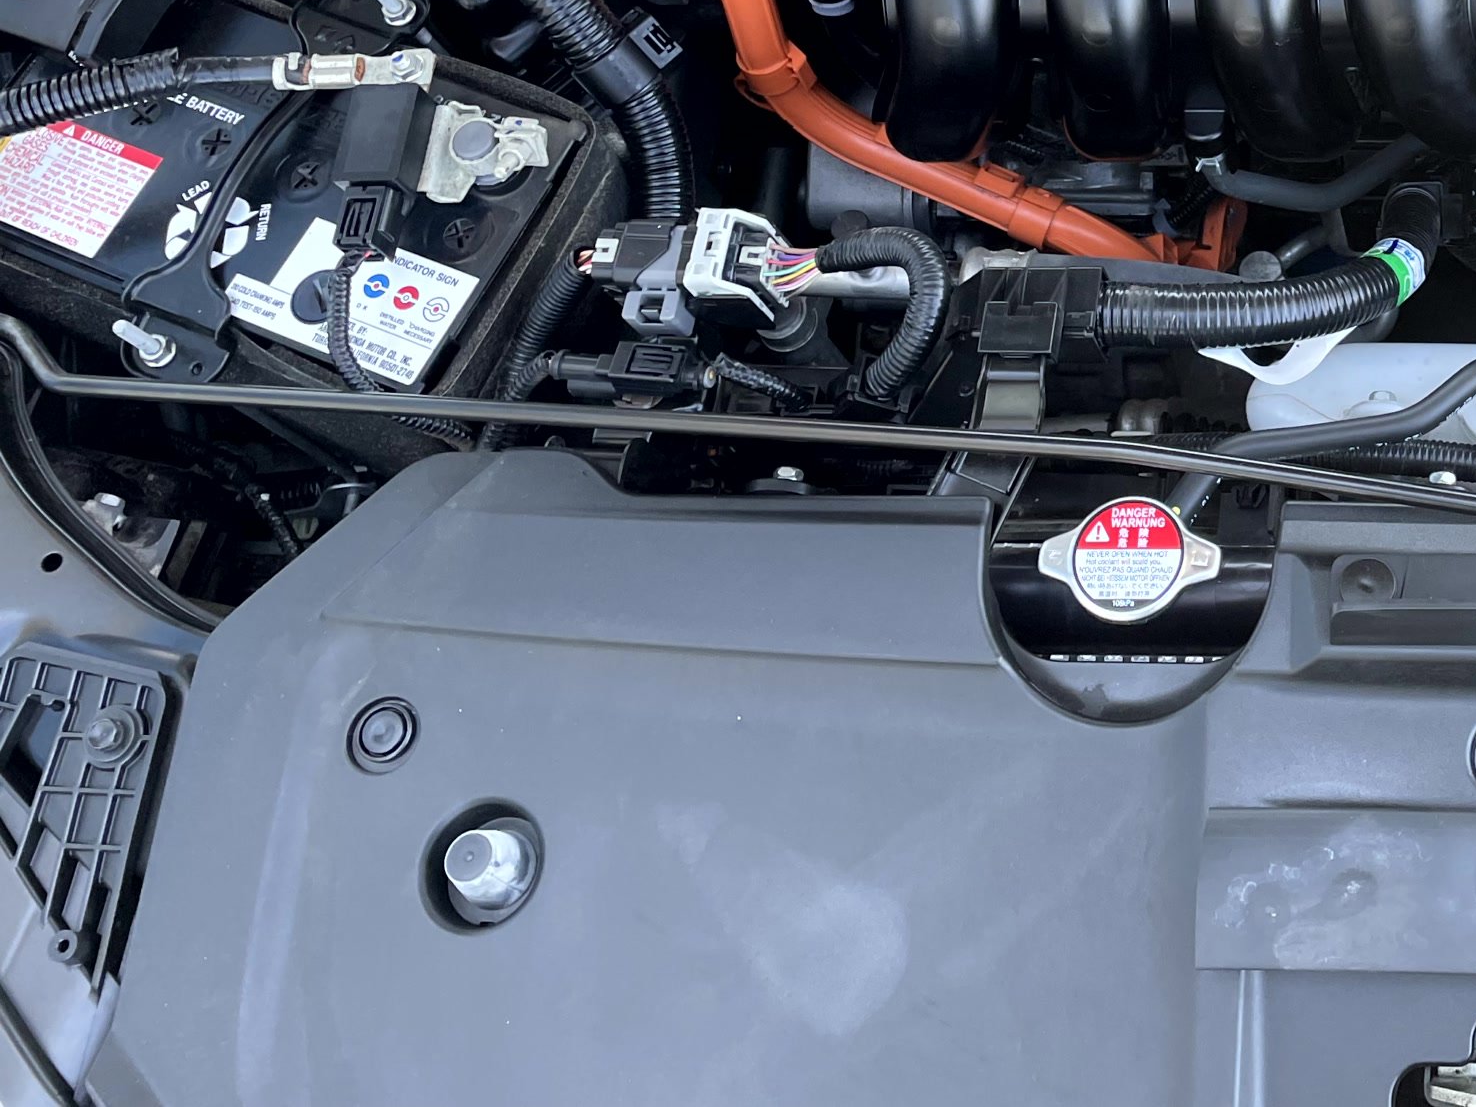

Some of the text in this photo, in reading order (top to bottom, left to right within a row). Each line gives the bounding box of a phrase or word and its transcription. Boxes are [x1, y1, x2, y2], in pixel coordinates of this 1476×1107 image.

[186, 96, 245, 126] BATTERY
[22, 134, 49, 152] GASES
[80, 129, 125, 155] DANGER
[2, 155, 36, 174] HAZARD
[181, 180, 211, 202] LEAD
[255, 203, 272, 241] RETURN
[392, 254, 460, 288] NDICATOR SIGN
[379, 311, 405, 326] DISTILLED
[379, 320, 397, 331] WATER
[365, 340, 387, 357] MOTOR
[1111, 507, 1157, 518] DANGER
[1111, 517, 1166, 528] WARNUNG
[1087, 550, 1168, 558] NEVER OPEN WHEN HOT
[1126, 566, 1149, 574] QUAND
